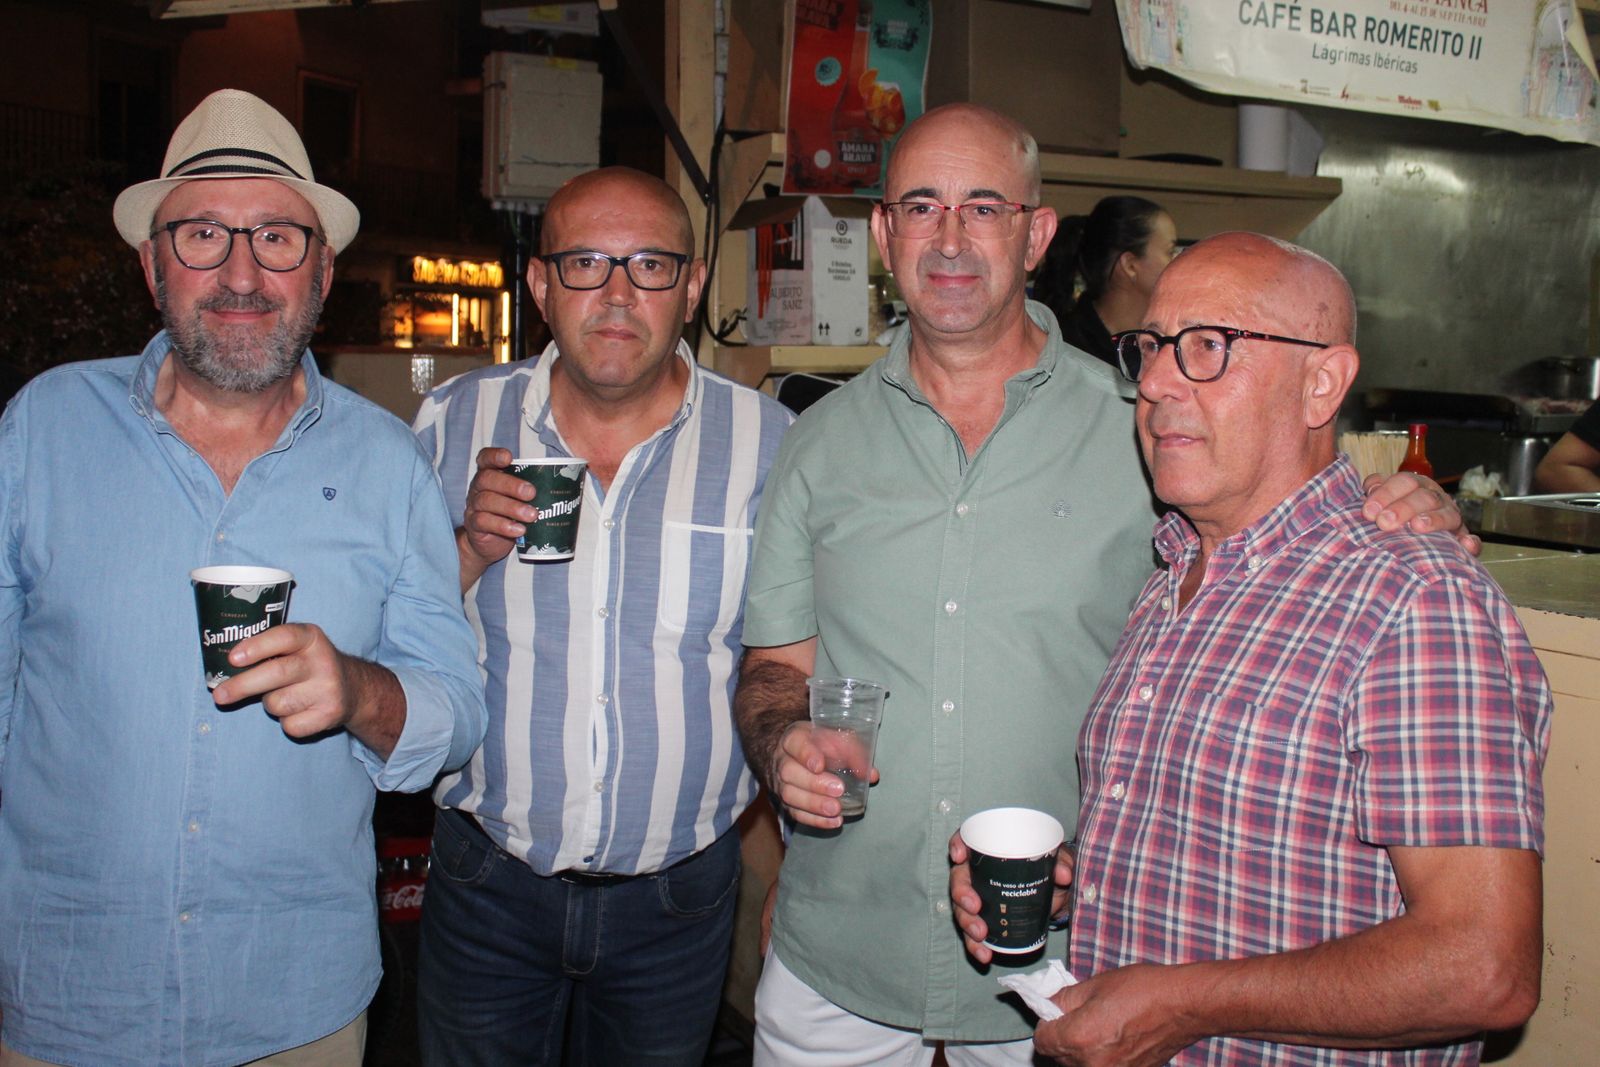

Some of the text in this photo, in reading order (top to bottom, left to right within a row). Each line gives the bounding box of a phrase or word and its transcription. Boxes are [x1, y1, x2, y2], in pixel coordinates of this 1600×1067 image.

[1439, 10, 1487, 27] SEPTIEMBRE
[1238, 0, 1482, 60] CAFÉ BAR ROMERITO II
[1312, 43, 1418, 74] Lágrimas Ibéricas
[841, 142, 875, 152] AMARA
[842, 152, 872, 162] BRAVA
[782, 299, 803, 310] SANZ
[203, 613, 271, 647] SanMiguel
[1001, 888, 1037, 897] reciclable
